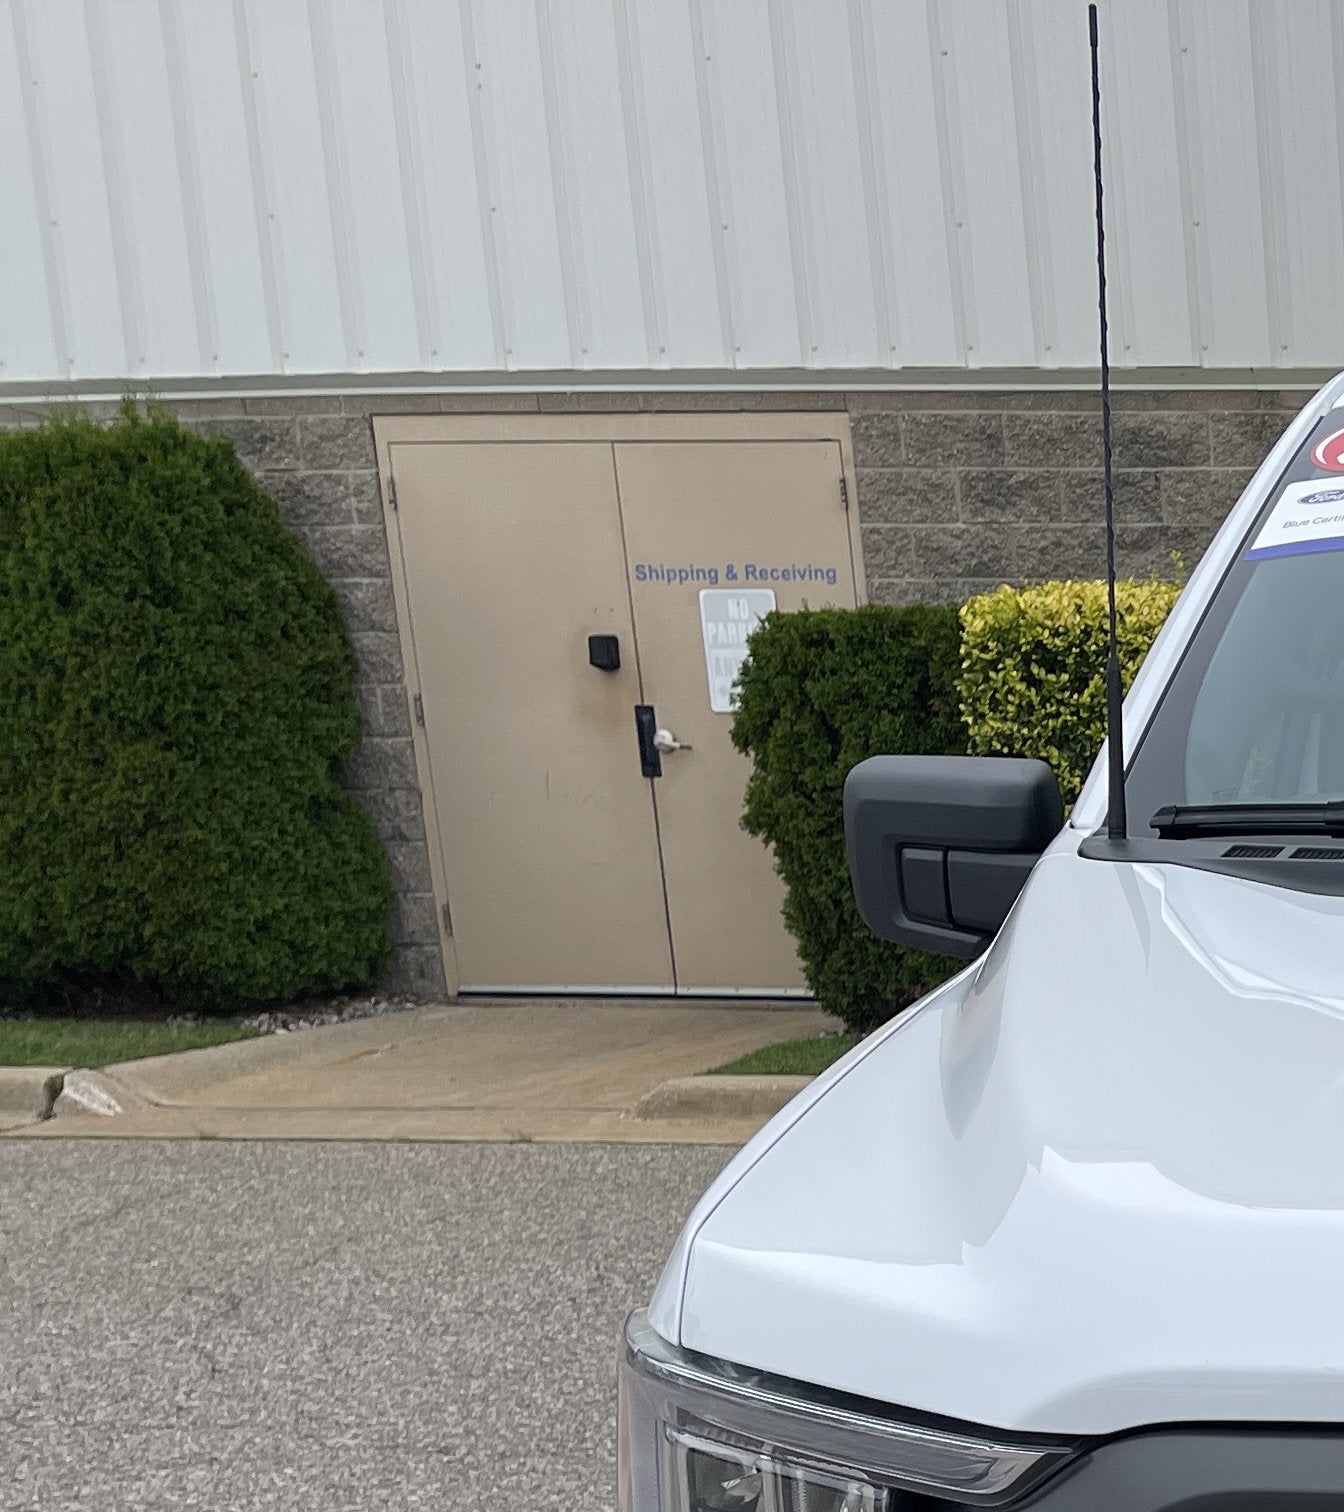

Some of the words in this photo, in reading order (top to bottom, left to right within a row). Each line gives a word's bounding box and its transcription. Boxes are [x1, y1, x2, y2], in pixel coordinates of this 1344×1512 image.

[1282, 518, 1310, 529] Blue
[635, 563, 719, 586] Shipping
[725, 563, 738, 581] &
[744, 563, 837, 586] Receiving
[727, 598, 749, 621] NO
